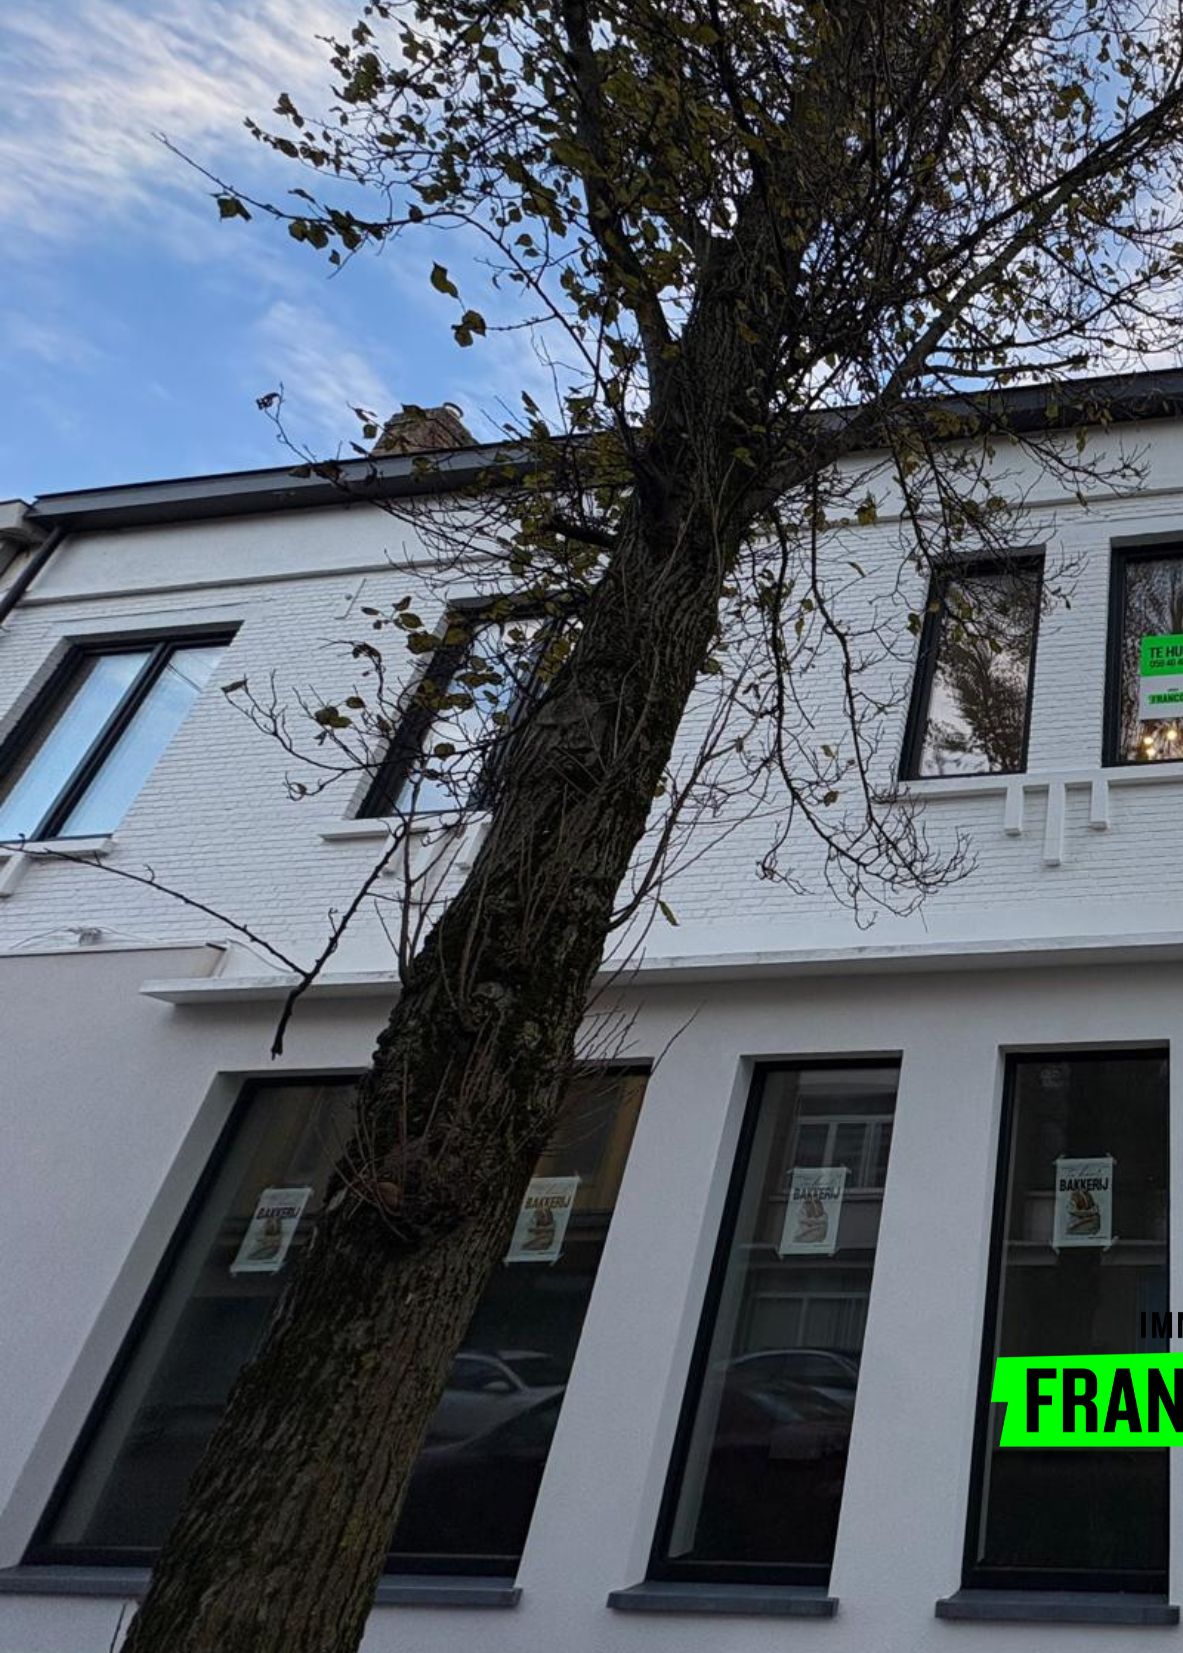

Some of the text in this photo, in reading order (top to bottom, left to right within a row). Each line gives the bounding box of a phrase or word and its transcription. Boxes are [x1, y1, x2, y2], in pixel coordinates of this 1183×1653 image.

[1149, 647, 1163, 658] TE
[1060, 1178, 1109, 1191] BAKKERIJ
[793, 1187, 840, 1200] BAKKERIJ
